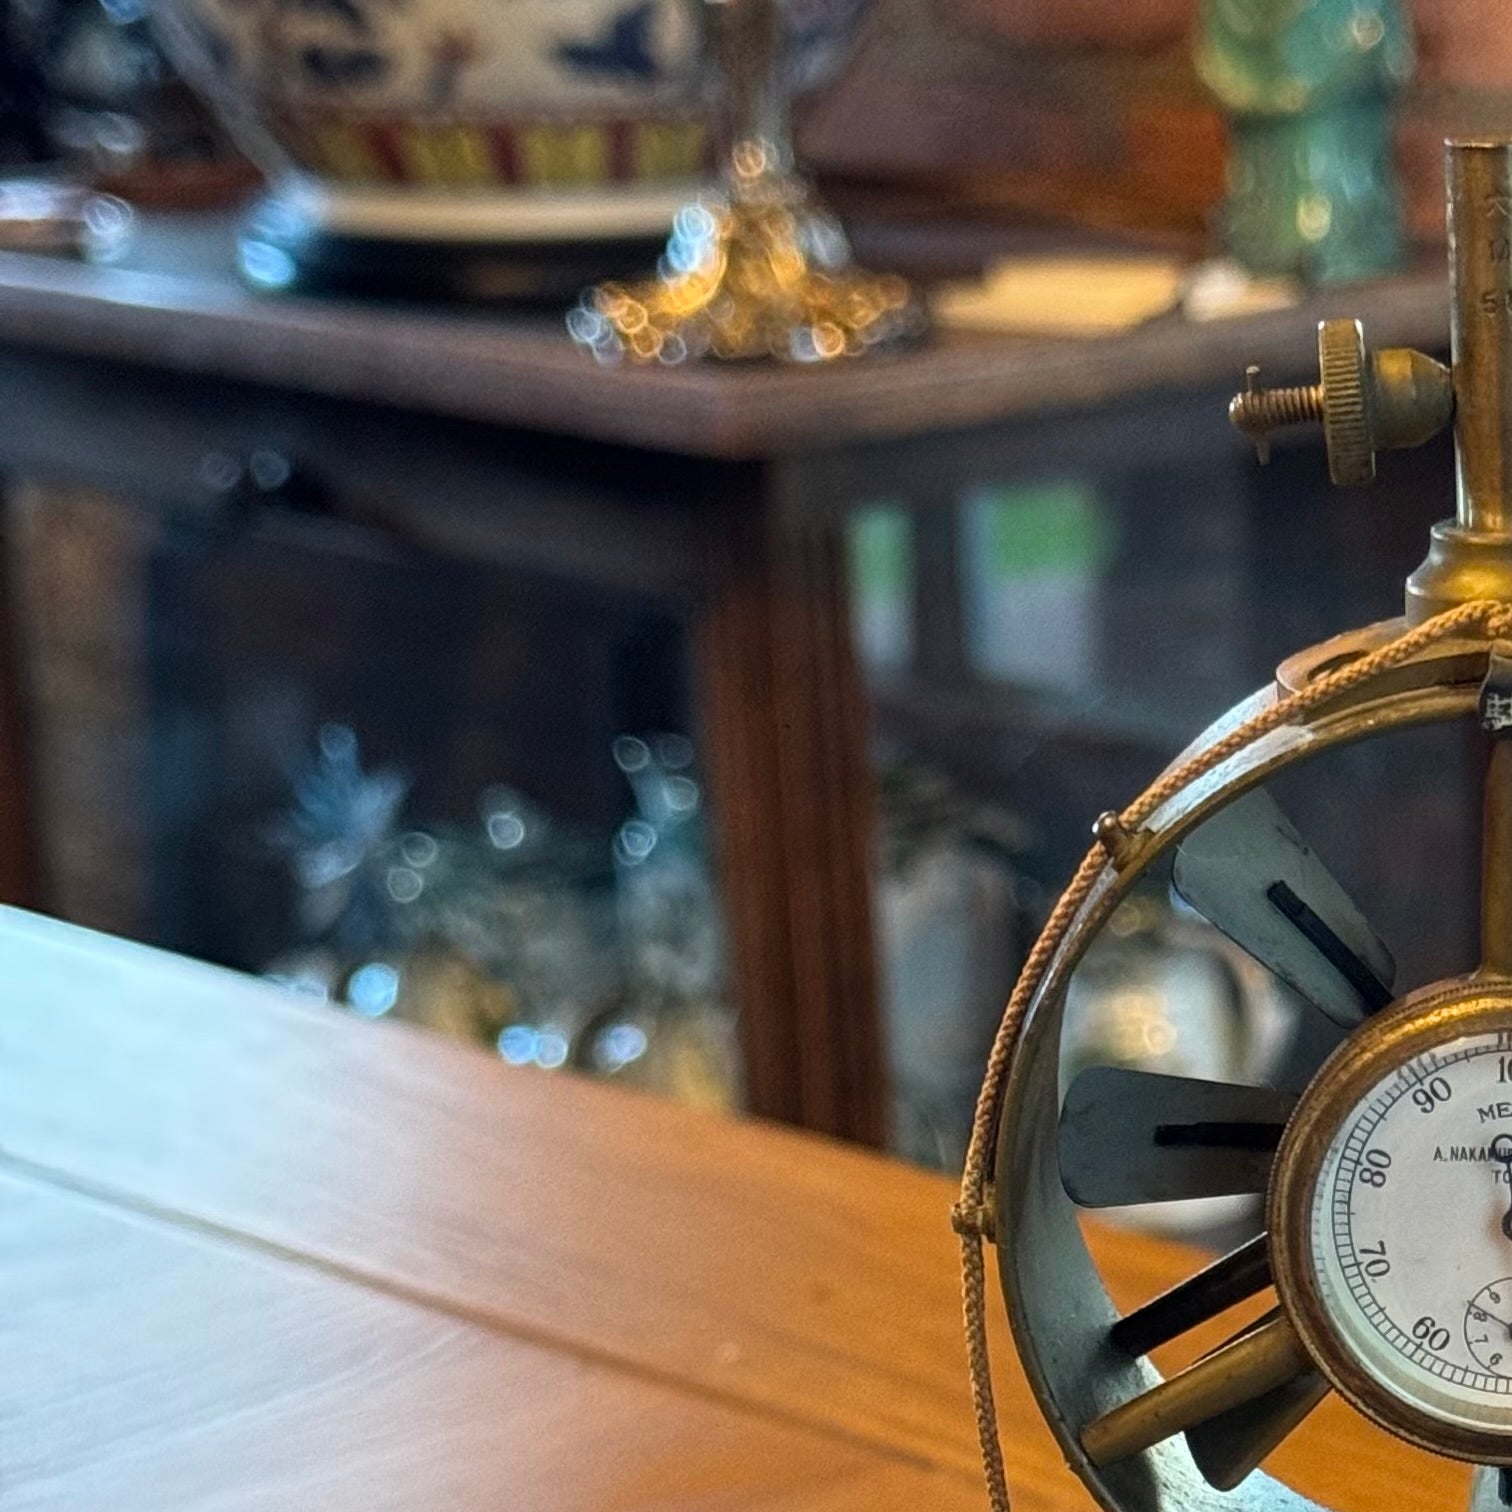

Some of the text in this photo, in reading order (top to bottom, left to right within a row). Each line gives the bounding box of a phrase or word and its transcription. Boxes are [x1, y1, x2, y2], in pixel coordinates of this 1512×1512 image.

[1411, 1077, 1451, 1113] 90
[1360, 1148, 1392, 1188] 80
[1359, 1241, 1391, 1279] 70
[1412, 1316, 1450, 1352] 60
[1475, 1334, 1489, 1343] 7
[1490, 1353, 1503, 1365] 6
